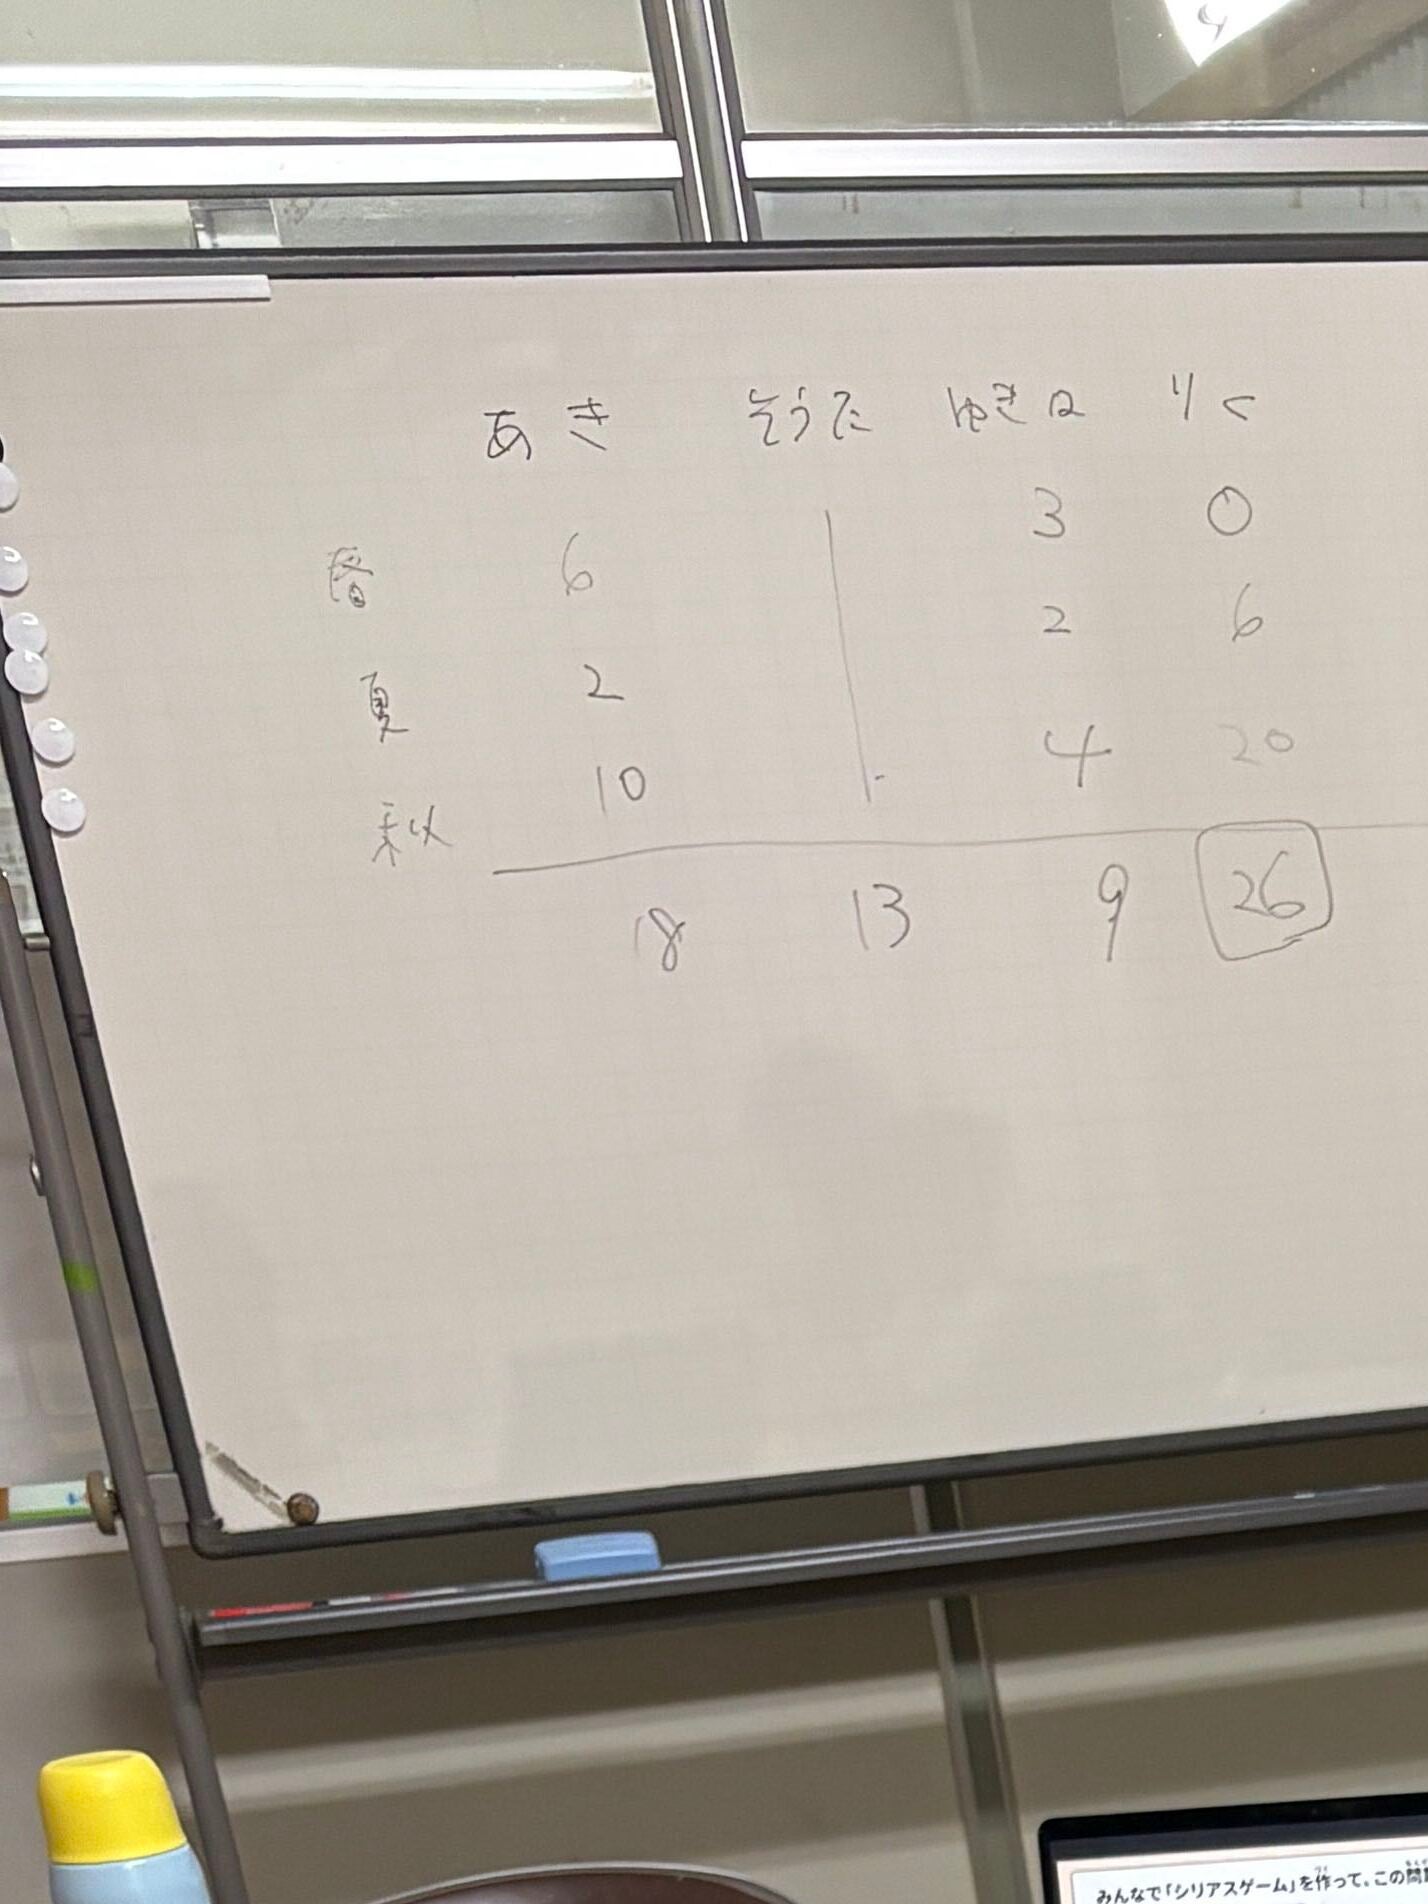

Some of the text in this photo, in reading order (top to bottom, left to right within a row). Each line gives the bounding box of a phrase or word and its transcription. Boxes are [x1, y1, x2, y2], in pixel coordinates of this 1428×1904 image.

[484, 397, 610, 461] あき
[1032, 485, 1253, 539] 3 0
[561, 531, 594, 597] 6
[1042, 582, 1264, 643] 2 6
[583, 663, 625, 701] 2
[1043, 723, 1295, 788] 4 20
[596, 765, 646, 819] 10
[634, 849, 1307, 972] 18 13 9 26
